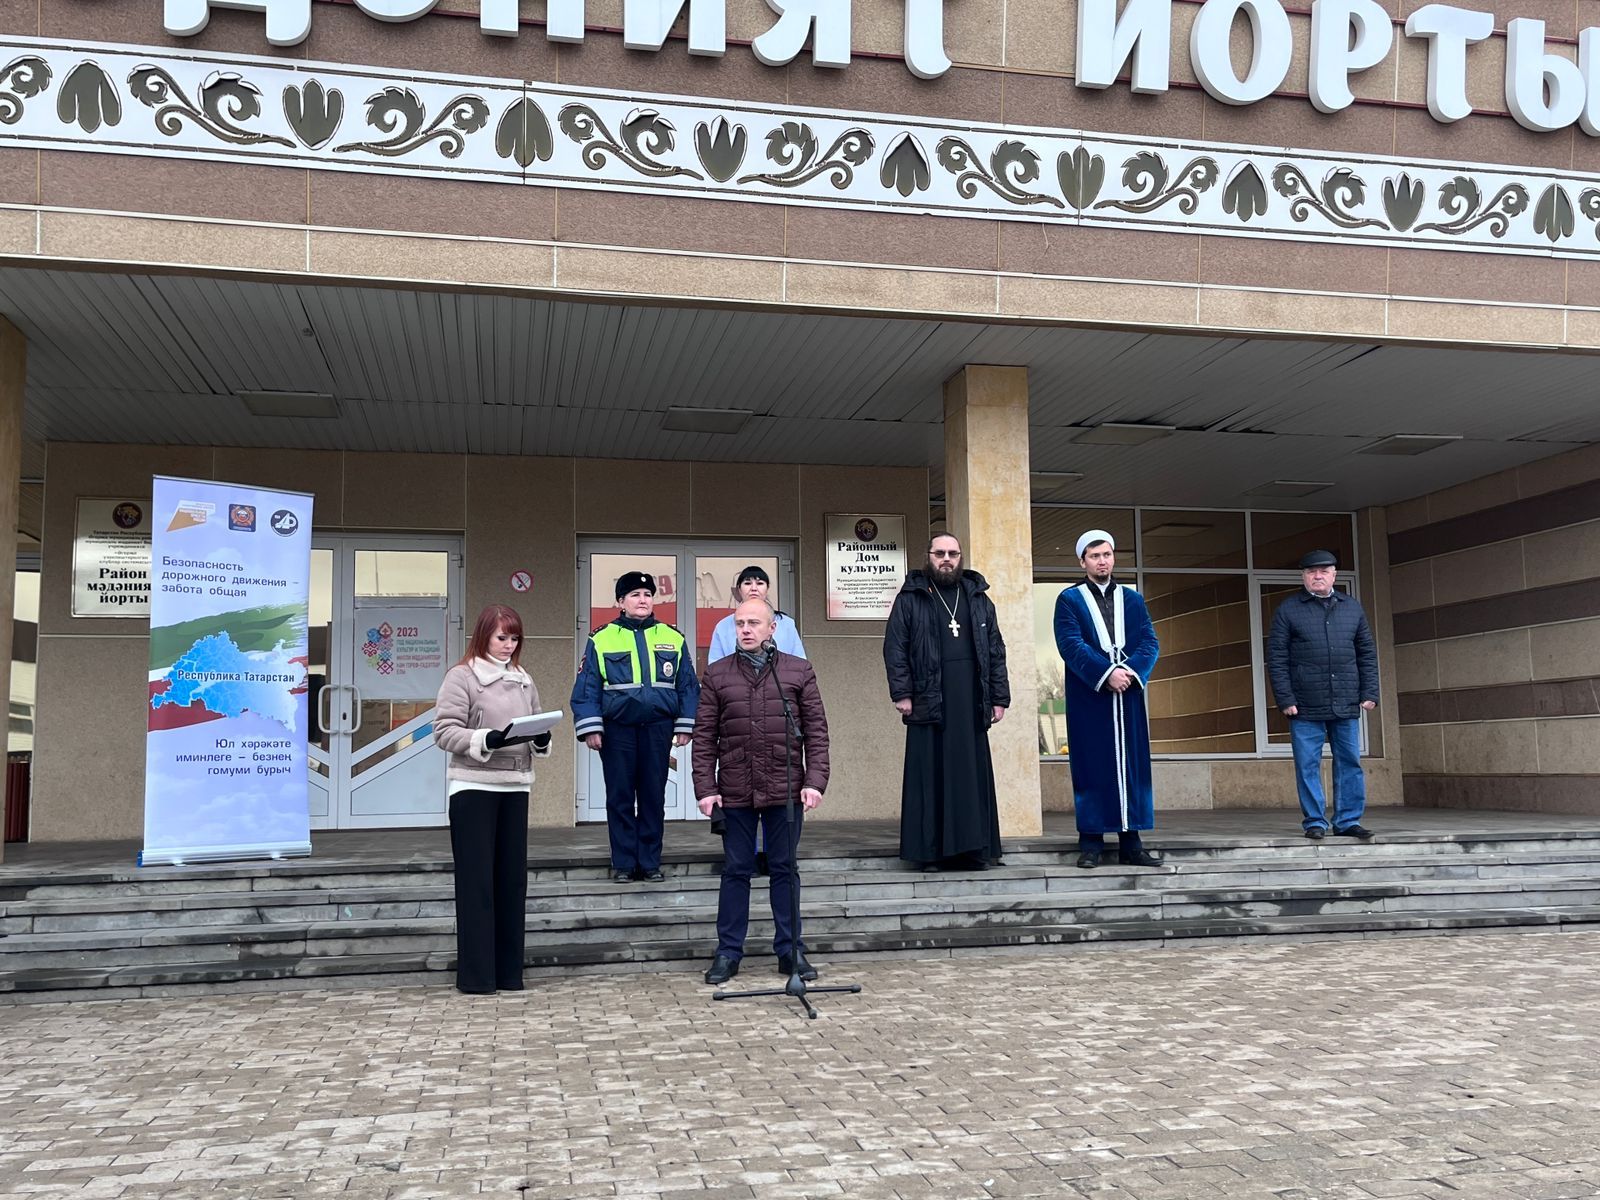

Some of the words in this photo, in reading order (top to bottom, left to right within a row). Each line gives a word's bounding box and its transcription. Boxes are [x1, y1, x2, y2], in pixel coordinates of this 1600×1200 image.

[837, 541, 897, 551] Районный
[855, 552, 880, 562] Дом
[162, 556, 244, 572] Безопасность
[99, 567, 147, 579] Район
[840, 565, 895, 575] культуры
[161, 571, 226, 583] дорожного
[232, 576, 287, 588] движения
[87, 582, 151, 592] мәдәния
[161, 583, 203, 595] забота
[209, 587, 247, 598] общая
[99, 592, 148, 605] йорты
[396, 627, 418, 637] 2023
[177, 670, 241, 683] Республика
[244, 671, 295, 684] Татарстан
[215, 738, 235, 749] Юл
[241, 741, 291, 751] хәрәкәте
[176, 754, 232, 762] иминлеге
[252, 753, 292, 763] безнең
[207, 766, 250, 777] гомуми
[257, 766, 291, 777] бурыч
